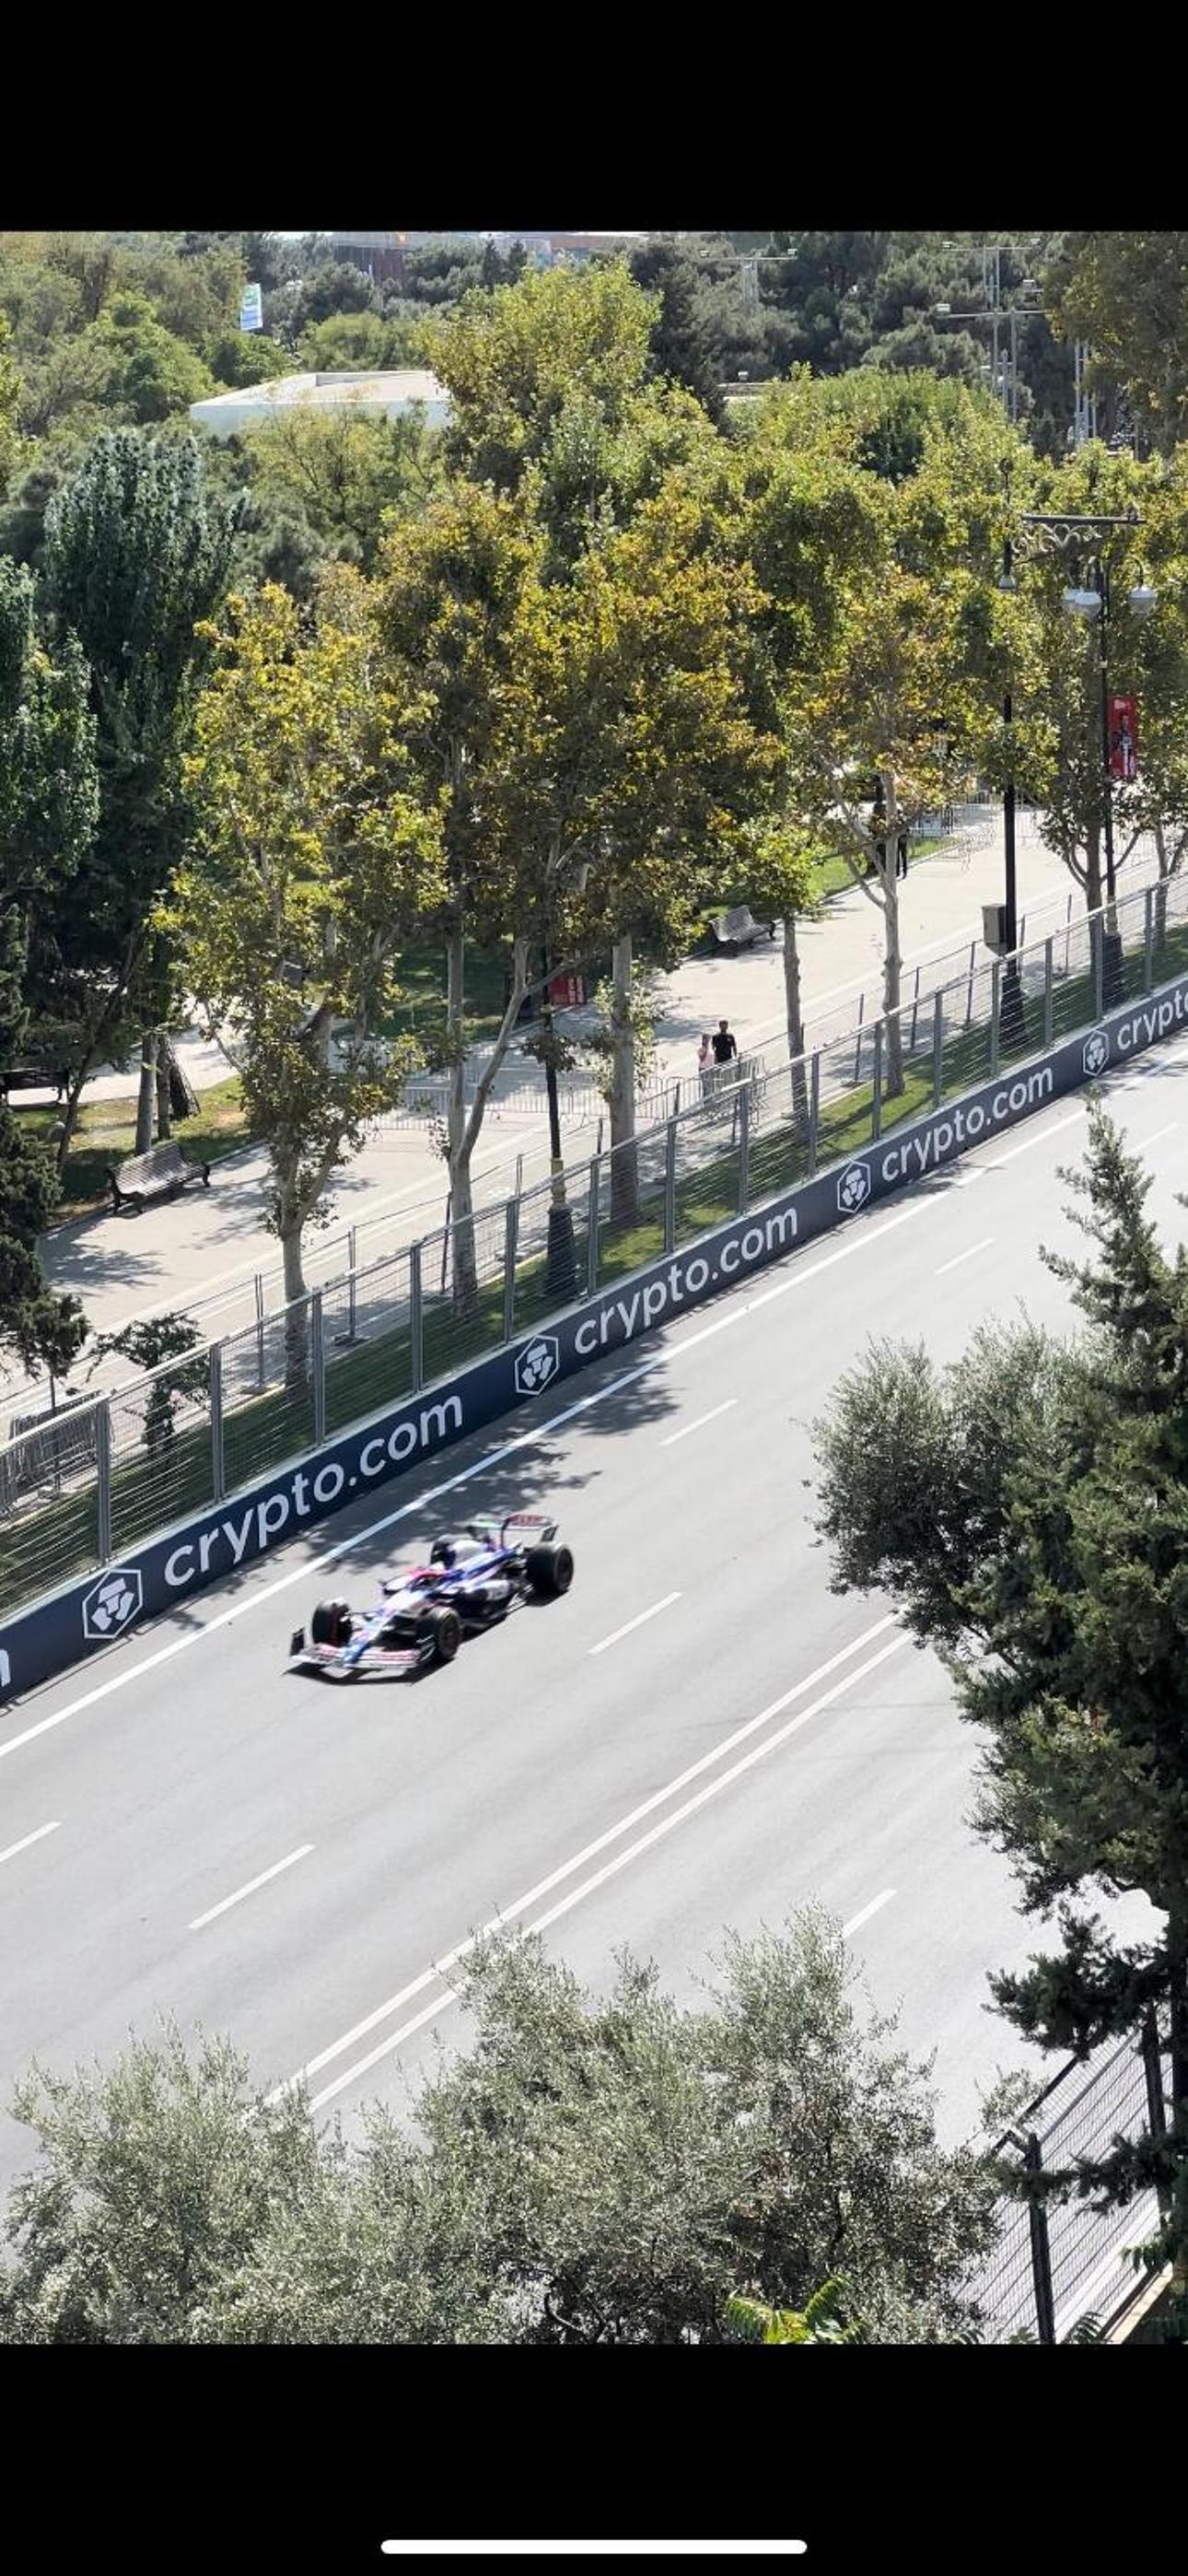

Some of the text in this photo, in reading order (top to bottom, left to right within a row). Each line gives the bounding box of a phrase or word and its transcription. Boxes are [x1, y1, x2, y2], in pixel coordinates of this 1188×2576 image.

[1117, 989, 1188, 1050] crypt
[881, 1066, 1053, 1182] crypto.com
[574, 1207, 798, 1354] crypto.com
[164, 1396, 462, 1587] crypto.com
